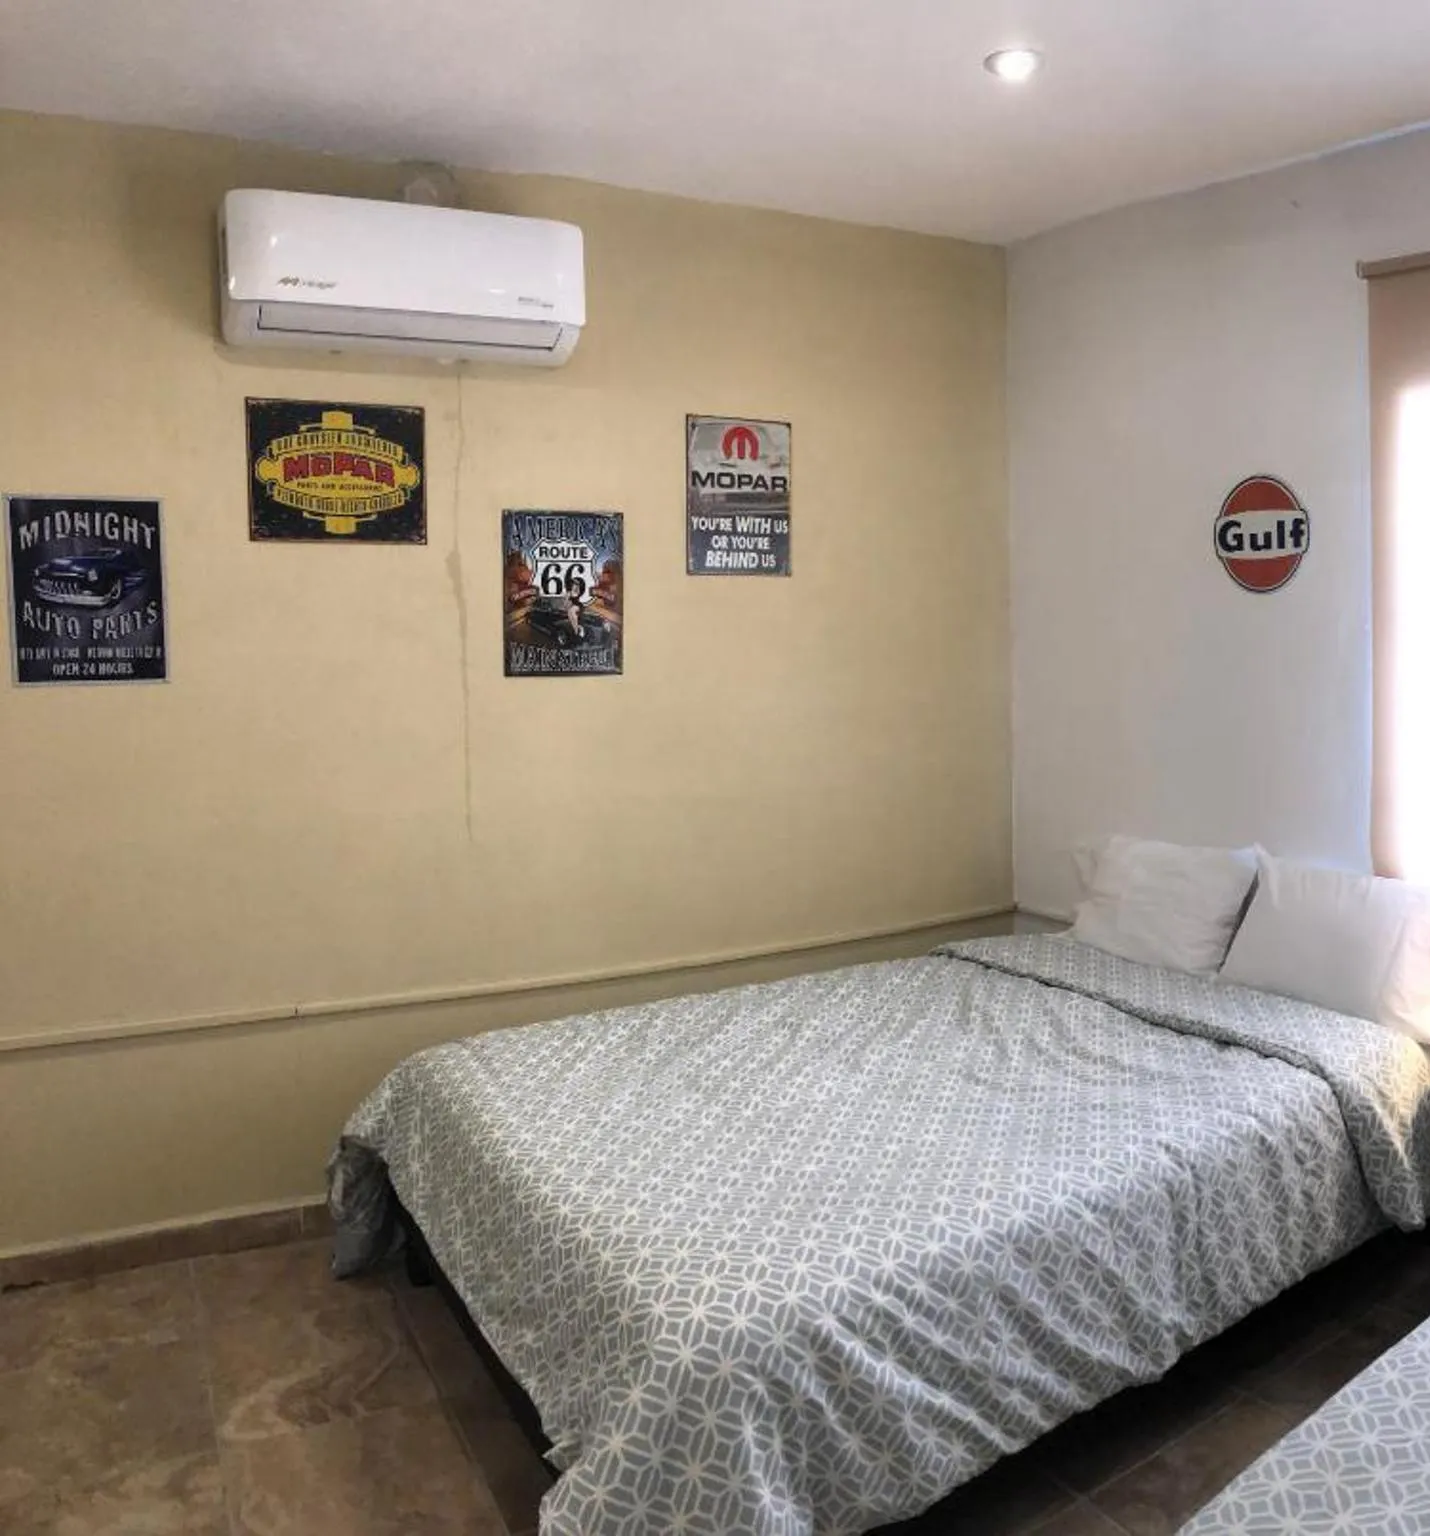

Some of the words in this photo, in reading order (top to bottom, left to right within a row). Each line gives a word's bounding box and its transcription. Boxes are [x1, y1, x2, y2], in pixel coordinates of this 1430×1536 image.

[283, 451, 395, 488] MOPAR
[691, 470, 788, 493] MOPAR
[18, 509, 156, 551] MIDNIGHT
[691, 516, 733, 531] YOU'RE
[735, 515, 772, 534] WITH
[773, 519, 788, 534] US
[1217, 517, 1306, 553] Gulf
[538, 546, 589, 559] ROUTE
[711, 535, 729, 549] OR
[730, 536, 770, 550] YOU'RE
[705, 550, 759, 569] BEHIND
[761, 554, 777, 568] US
[541, 562, 586, 598] 66
[22, 601, 81, 639] AUTO
[92, 600, 158, 640] PARTS
[52, 661, 80, 676] OPEN
[82, 661, 96, 676] 24
